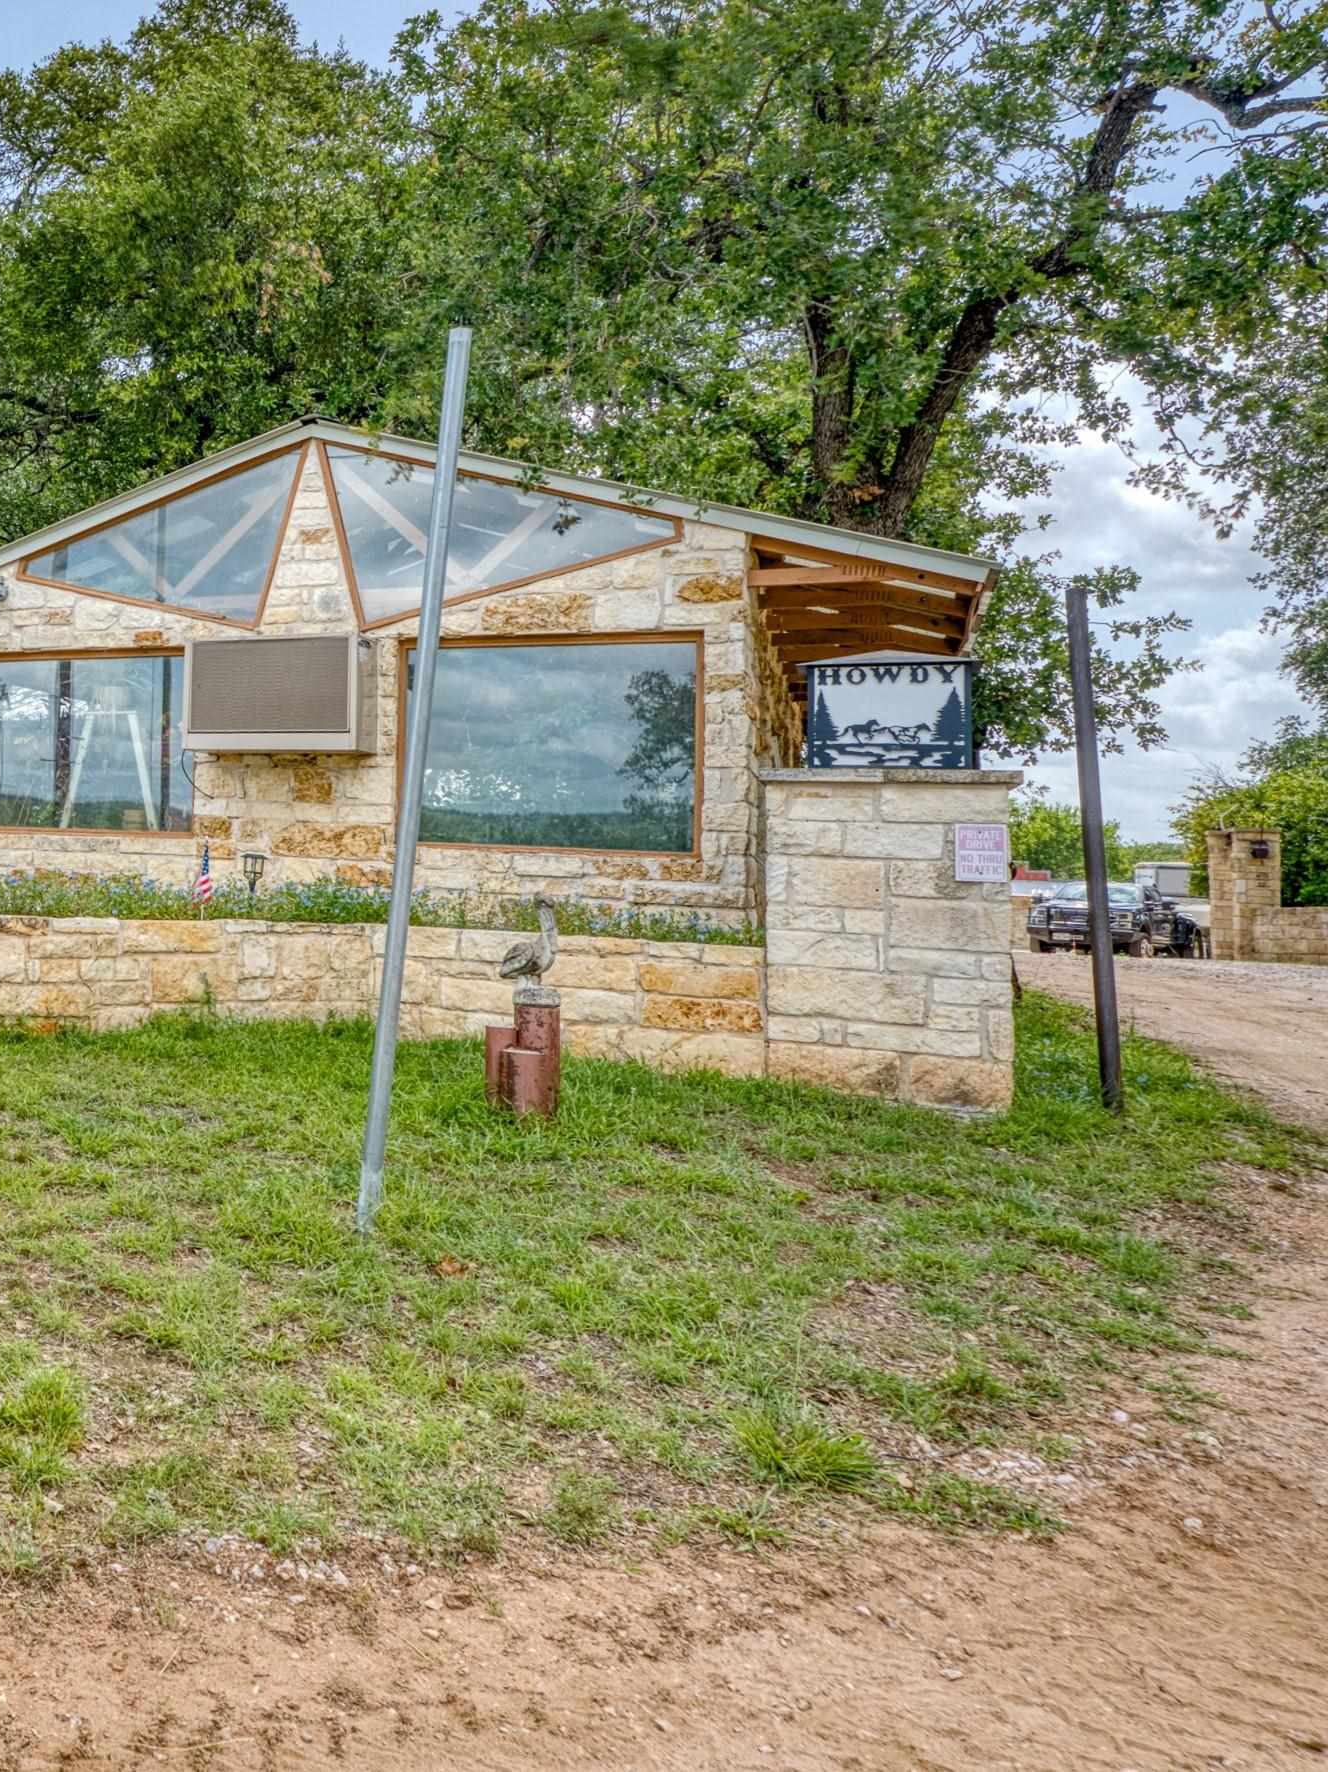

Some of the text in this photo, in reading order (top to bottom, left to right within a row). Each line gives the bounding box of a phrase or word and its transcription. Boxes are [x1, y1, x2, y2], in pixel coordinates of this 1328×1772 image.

[817, 666, 959, 686] HOWDY
[960, 831, 1002, 840] PRIVATE
[966, 840, 996, 849] DRIVE
[960, 855, 1002, 864] NO THRU
[961, 864, 1002, 874] TRAFFIC
